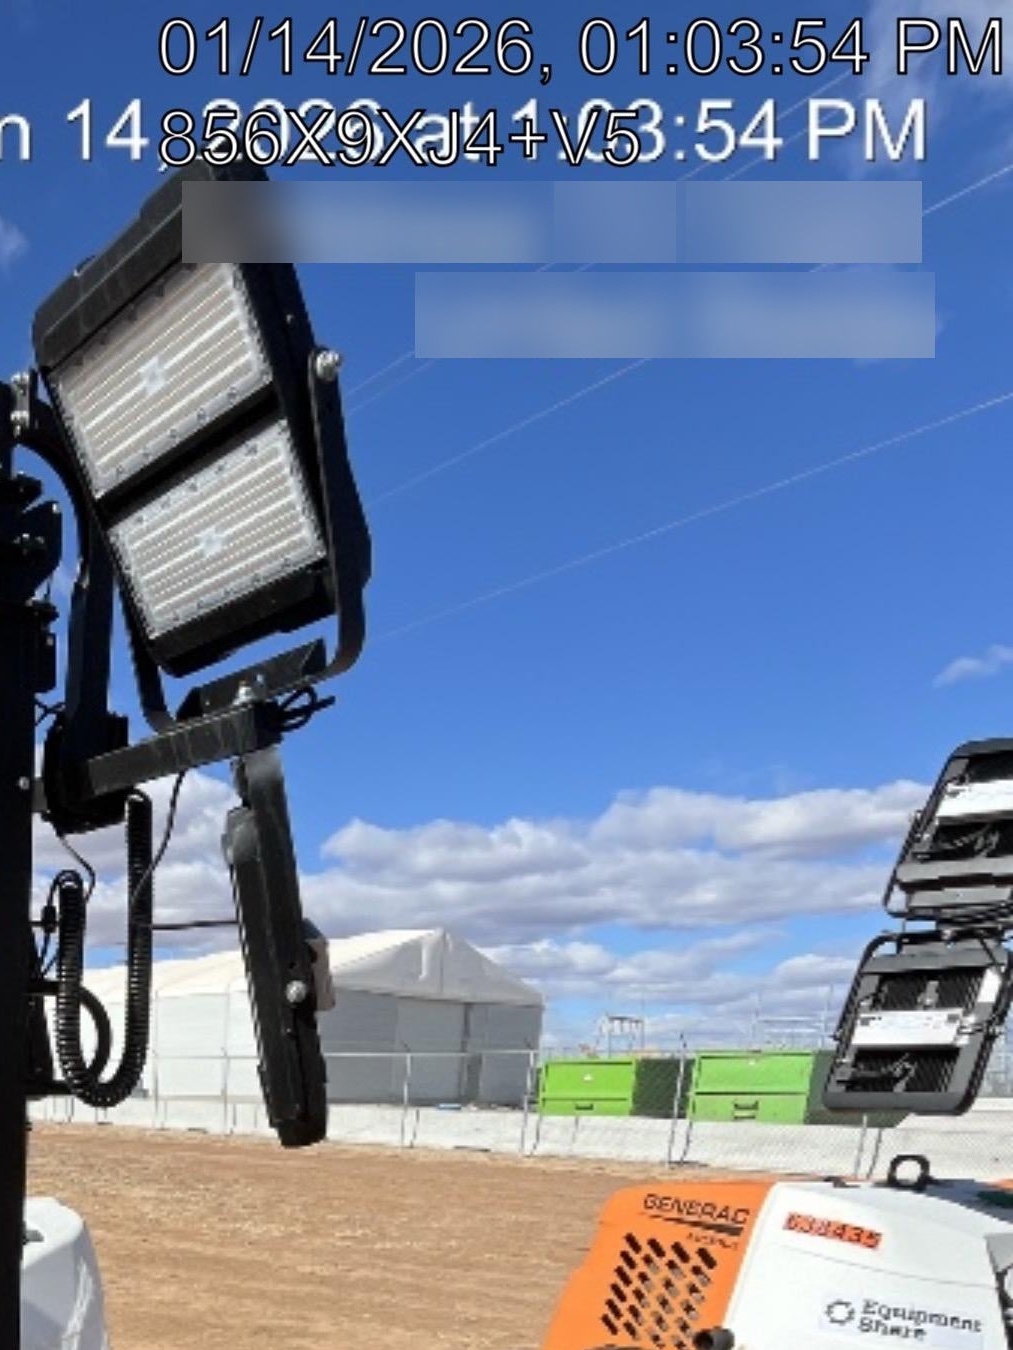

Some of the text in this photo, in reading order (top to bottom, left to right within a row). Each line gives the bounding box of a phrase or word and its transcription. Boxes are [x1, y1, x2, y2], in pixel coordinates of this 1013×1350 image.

[644, 1193, 750, 1226] GENERAC
[857, 1316, 927, 1342] Share
[862, 1299, 982, 1333] Equipment
